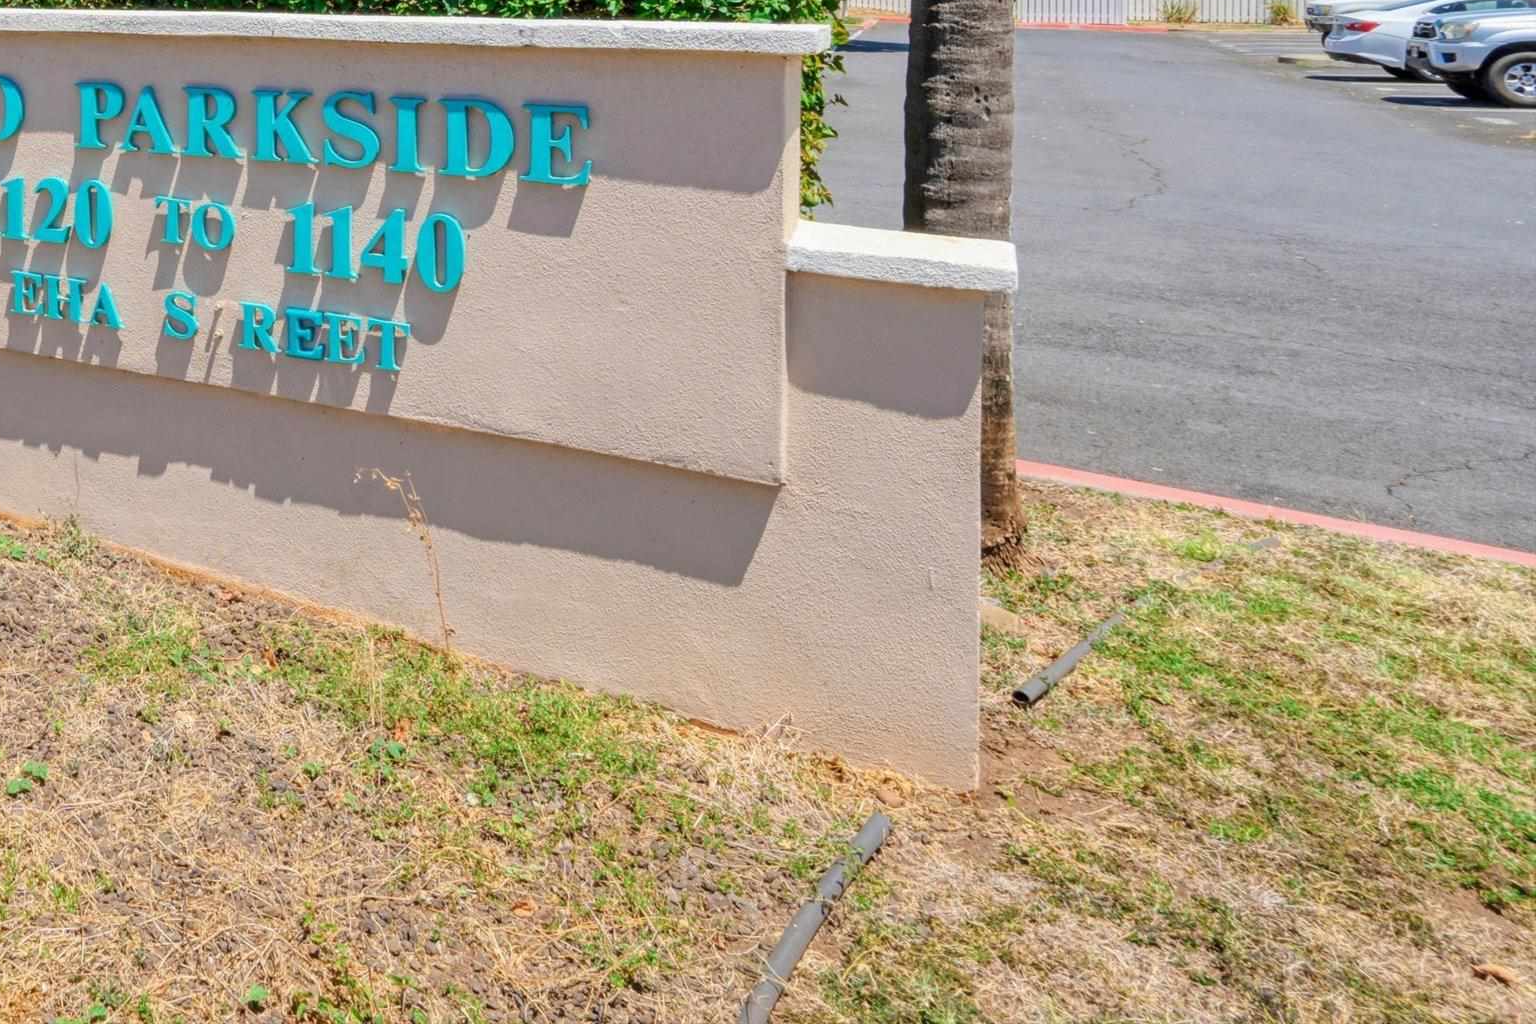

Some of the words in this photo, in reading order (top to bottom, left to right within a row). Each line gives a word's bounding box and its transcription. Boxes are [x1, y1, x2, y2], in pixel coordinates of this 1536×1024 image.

[75, 80, 594, 188] PARKSIDE
[154, 193, 237, 252] TO
[286, 201, 466, 295] 1140
[10, 269, 124, 330] EHA
[163, 290, 413, 372] SREET
